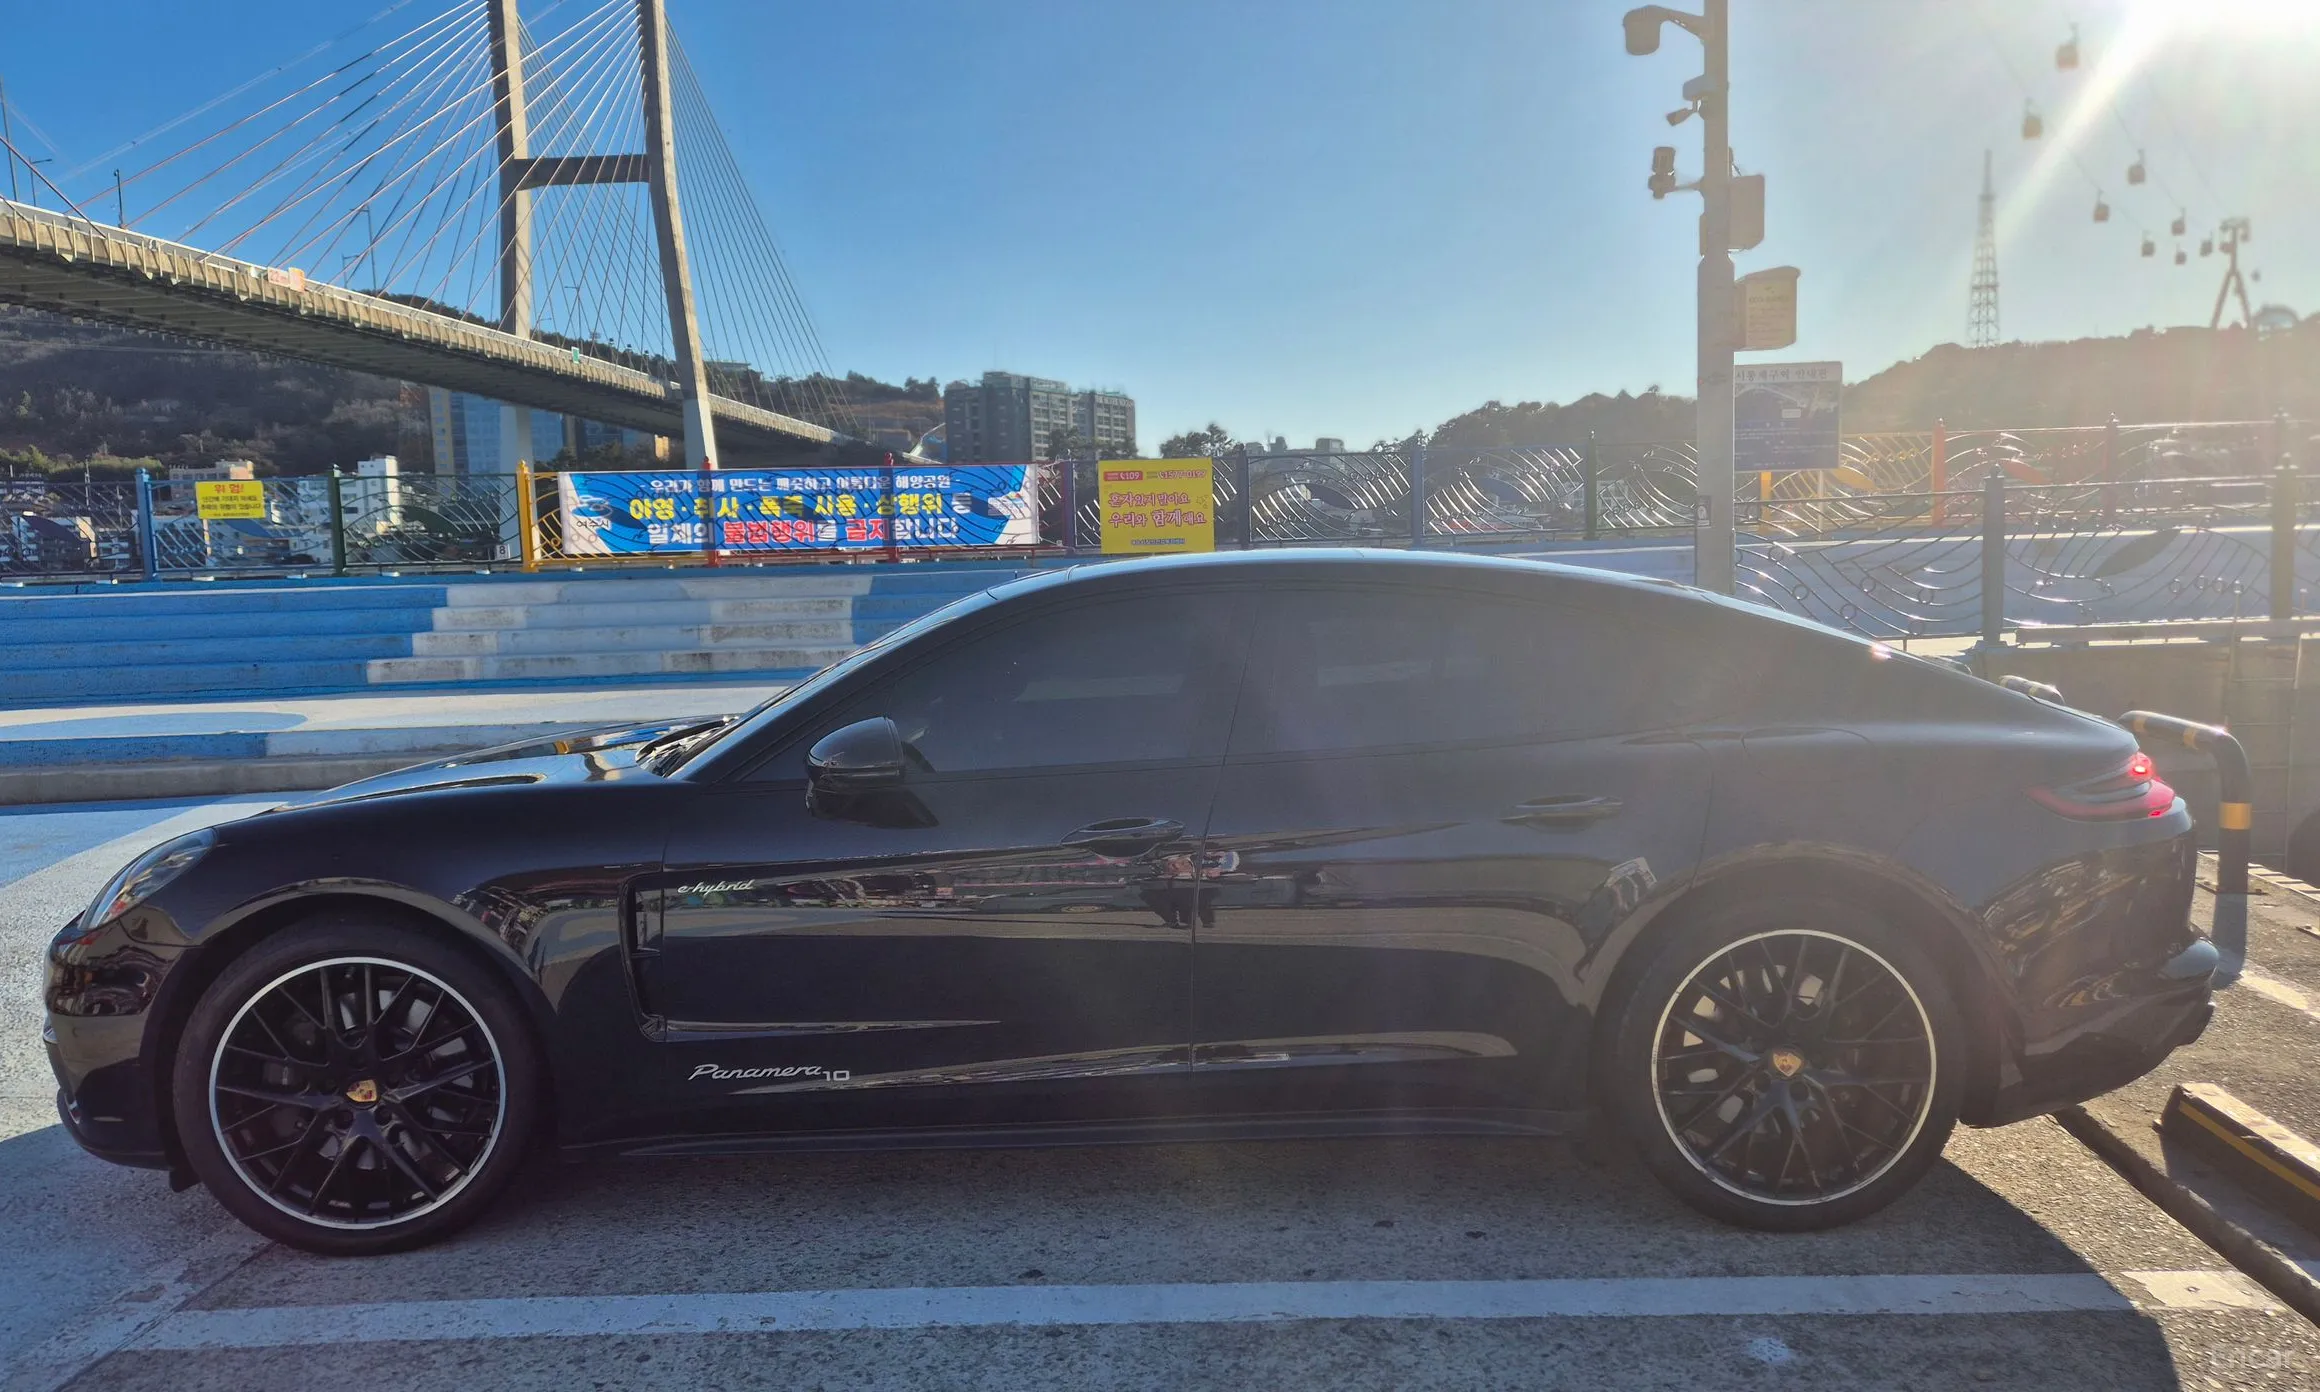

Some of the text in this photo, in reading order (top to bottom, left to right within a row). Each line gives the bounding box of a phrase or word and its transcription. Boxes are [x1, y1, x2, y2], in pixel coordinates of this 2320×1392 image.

[650, 479, 693, 496] 우리가
[729, 477, 769, 493] 만드는
[776, 476, 832, 492] 깨끗하고
[895, 474, 951, 490] 해양공원
[629, 497, 675, 521] 야영
[814, 494, 856, 518] 사용
[877, 493, 942, 516] 상행위
[952, 492, 972, 515] 등
[647, 521, 714, 545] 일체의
[723, 519, 837, 545] 불법행위를
[499, 545, 506, 554] 8
[687, 1063, 850, 1082] Panamera 10
